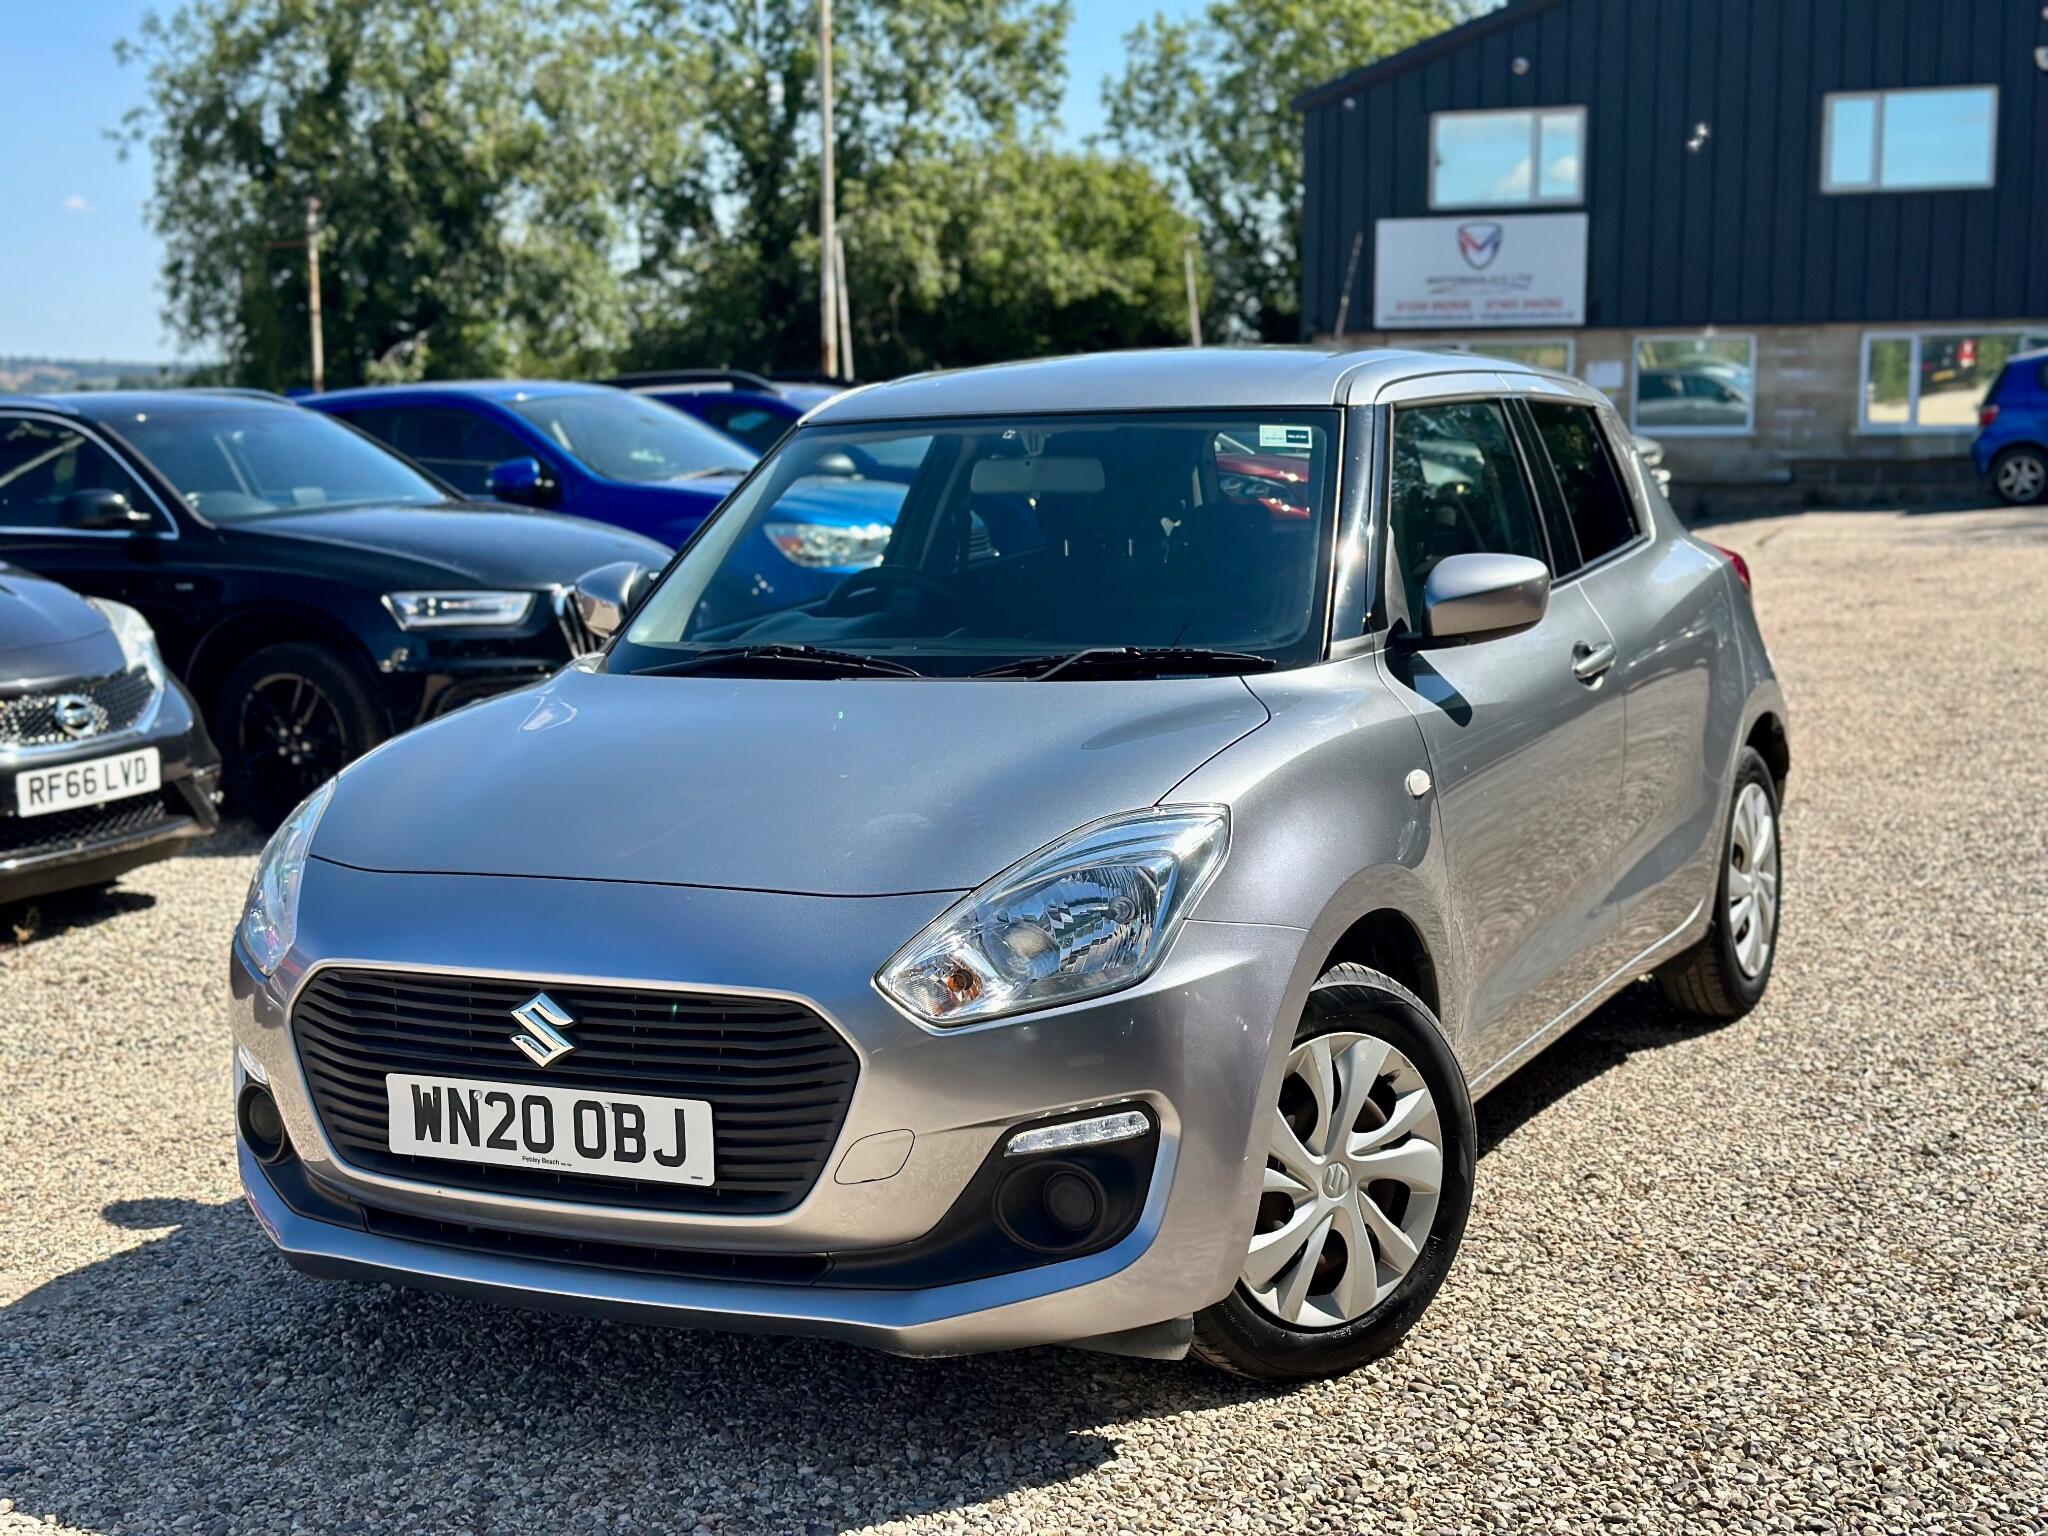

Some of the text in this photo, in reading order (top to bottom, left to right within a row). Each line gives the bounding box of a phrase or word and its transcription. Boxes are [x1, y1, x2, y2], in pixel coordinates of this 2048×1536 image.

[29, 757, 147, 806] RF66 LVD
[410, 1084, 687, 1168] WN20 OBJ
[541, 1157, 560, 1165] Beach
